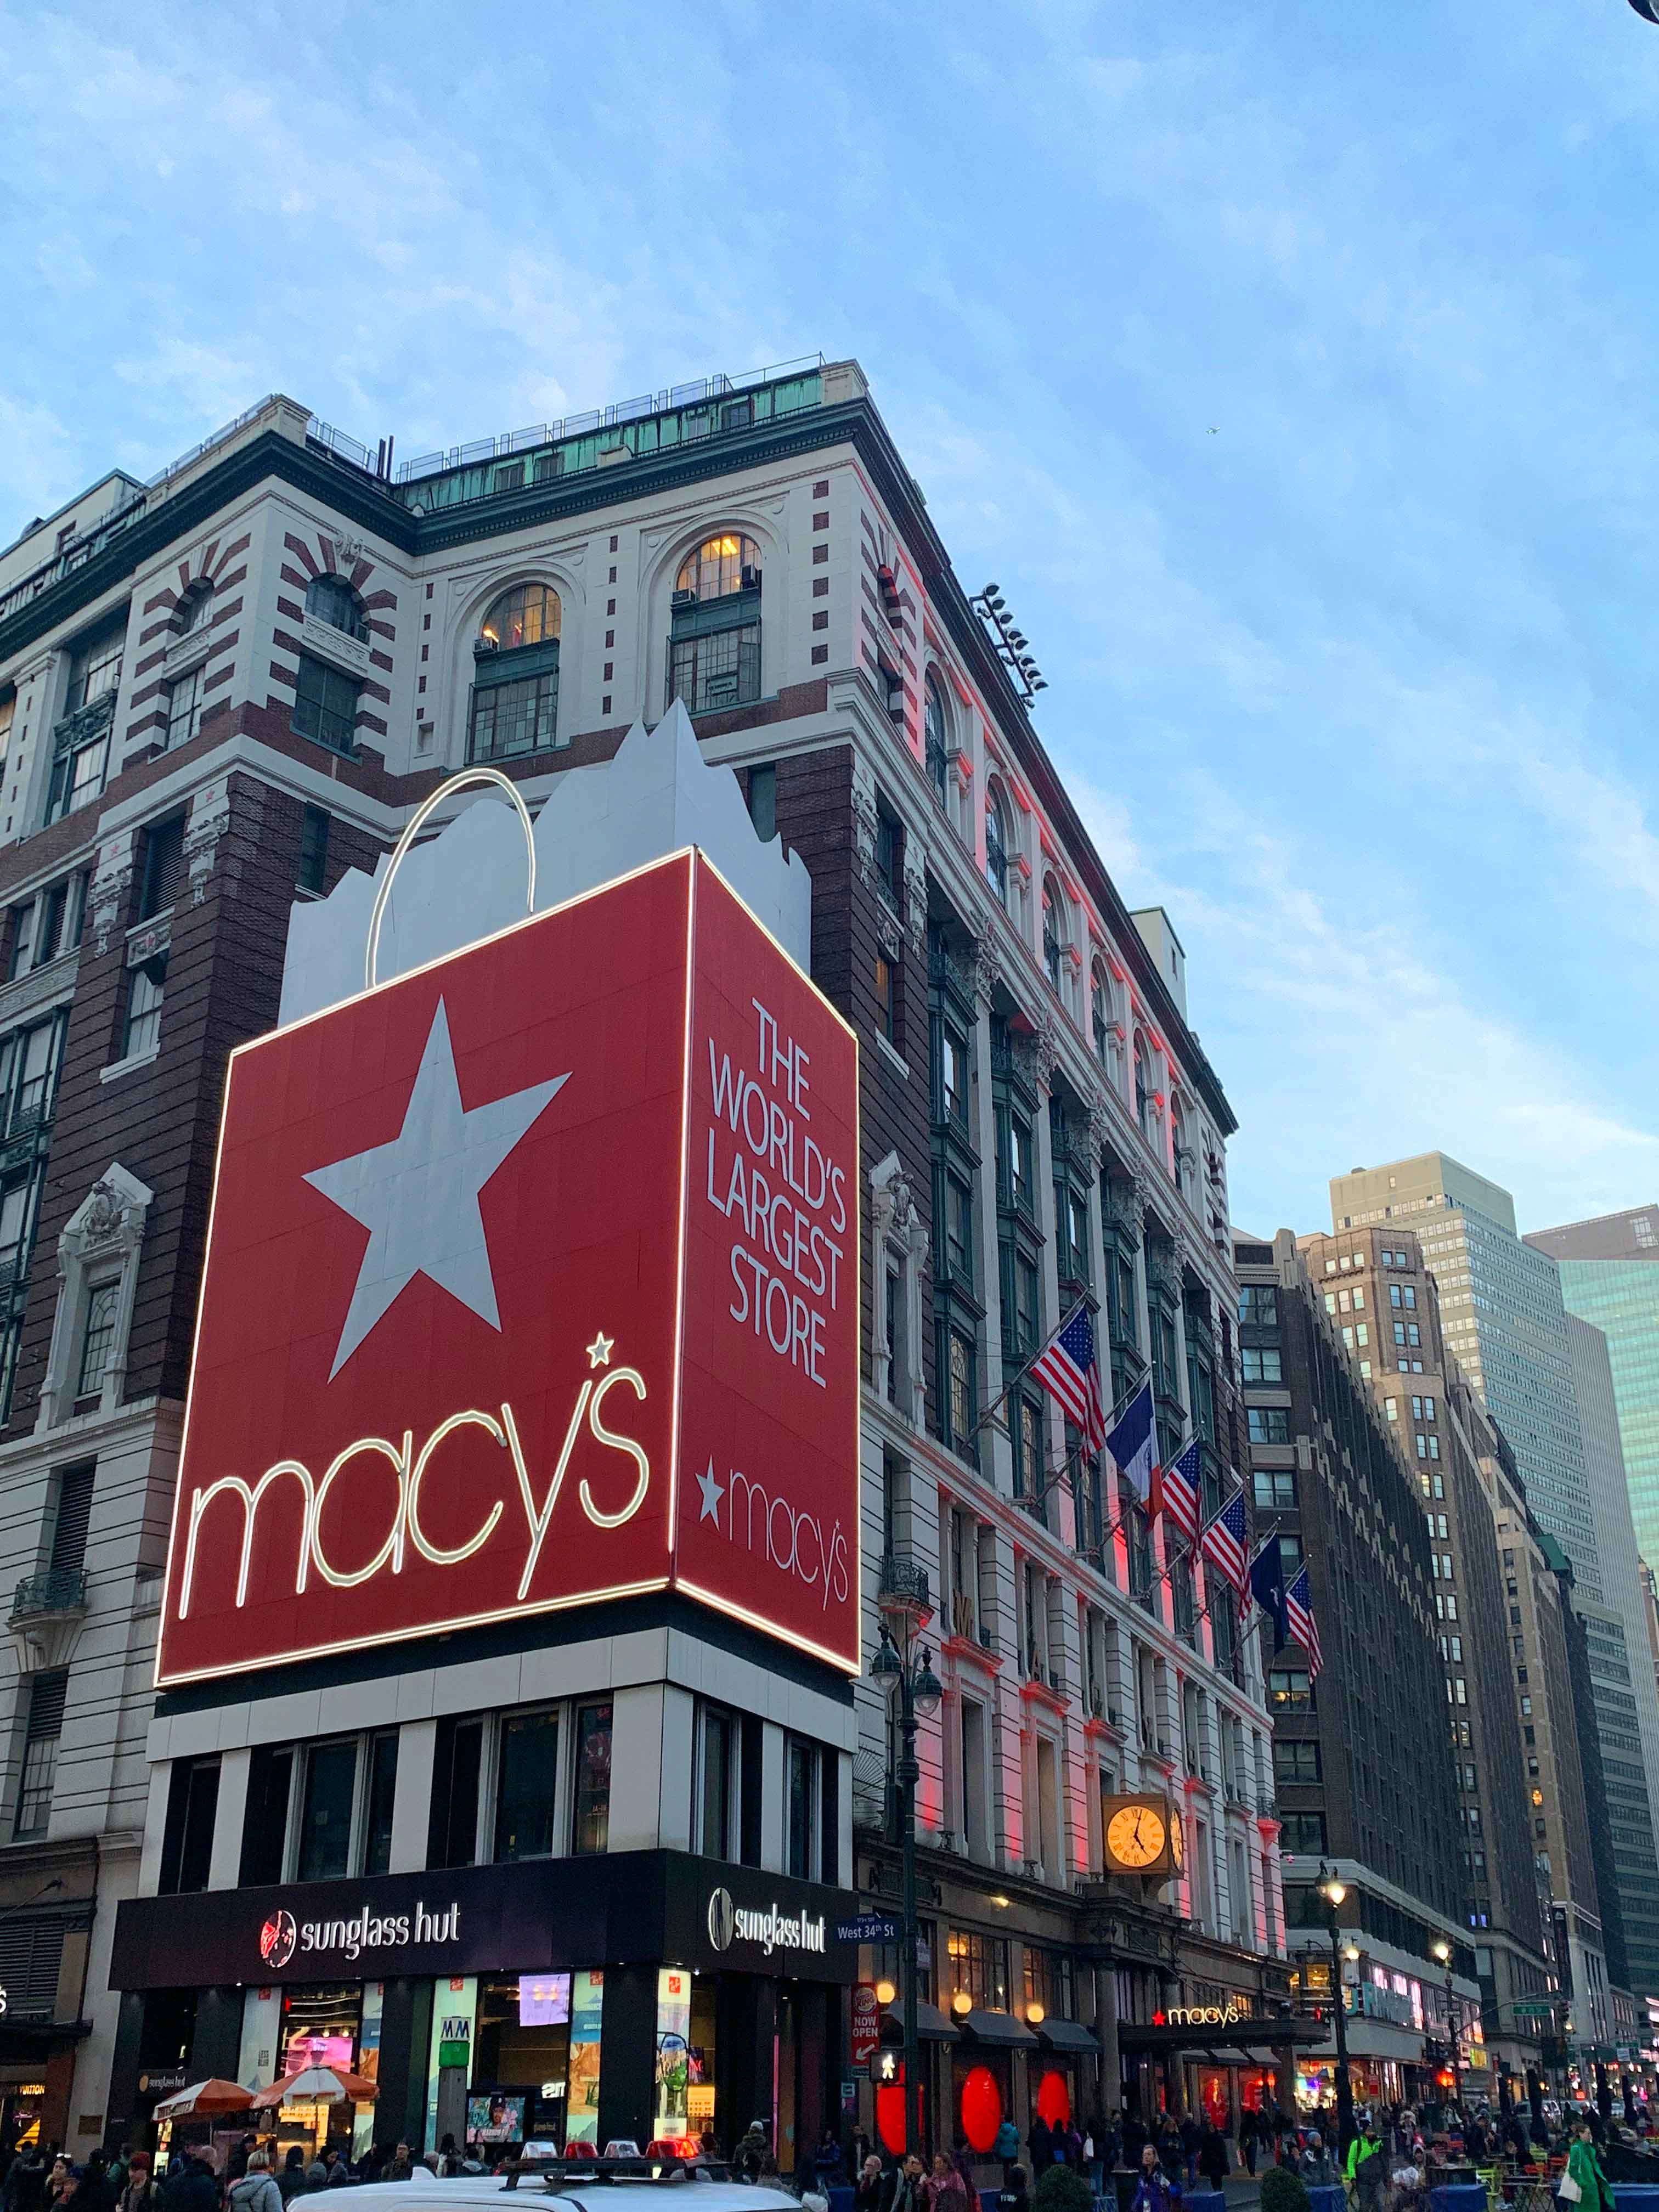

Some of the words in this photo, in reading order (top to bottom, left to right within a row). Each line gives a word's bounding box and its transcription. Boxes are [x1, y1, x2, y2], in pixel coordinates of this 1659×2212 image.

[752, 996, 810, 1121] THE
[709, 1037, 847, 1234] WORLD'S
[707, 1127, 844, 1311] LARGEST
[730, 1244, 826, 1389] STORE
[301, 1904, 410, 1960] sunglass
[414, 1900, 461, 1943] hut
[735, 1903, 800, 1956] sunglass
[802, 1909, 826, 1953] hut
[837, 1926, 862, 1939] West
[864, 1923, 882, 1937] 34th
[884, 1923, 894, 1937] St
[852, 2028, 878, 2038] OPEN
[854, 2016, 876, 2026] NOW
